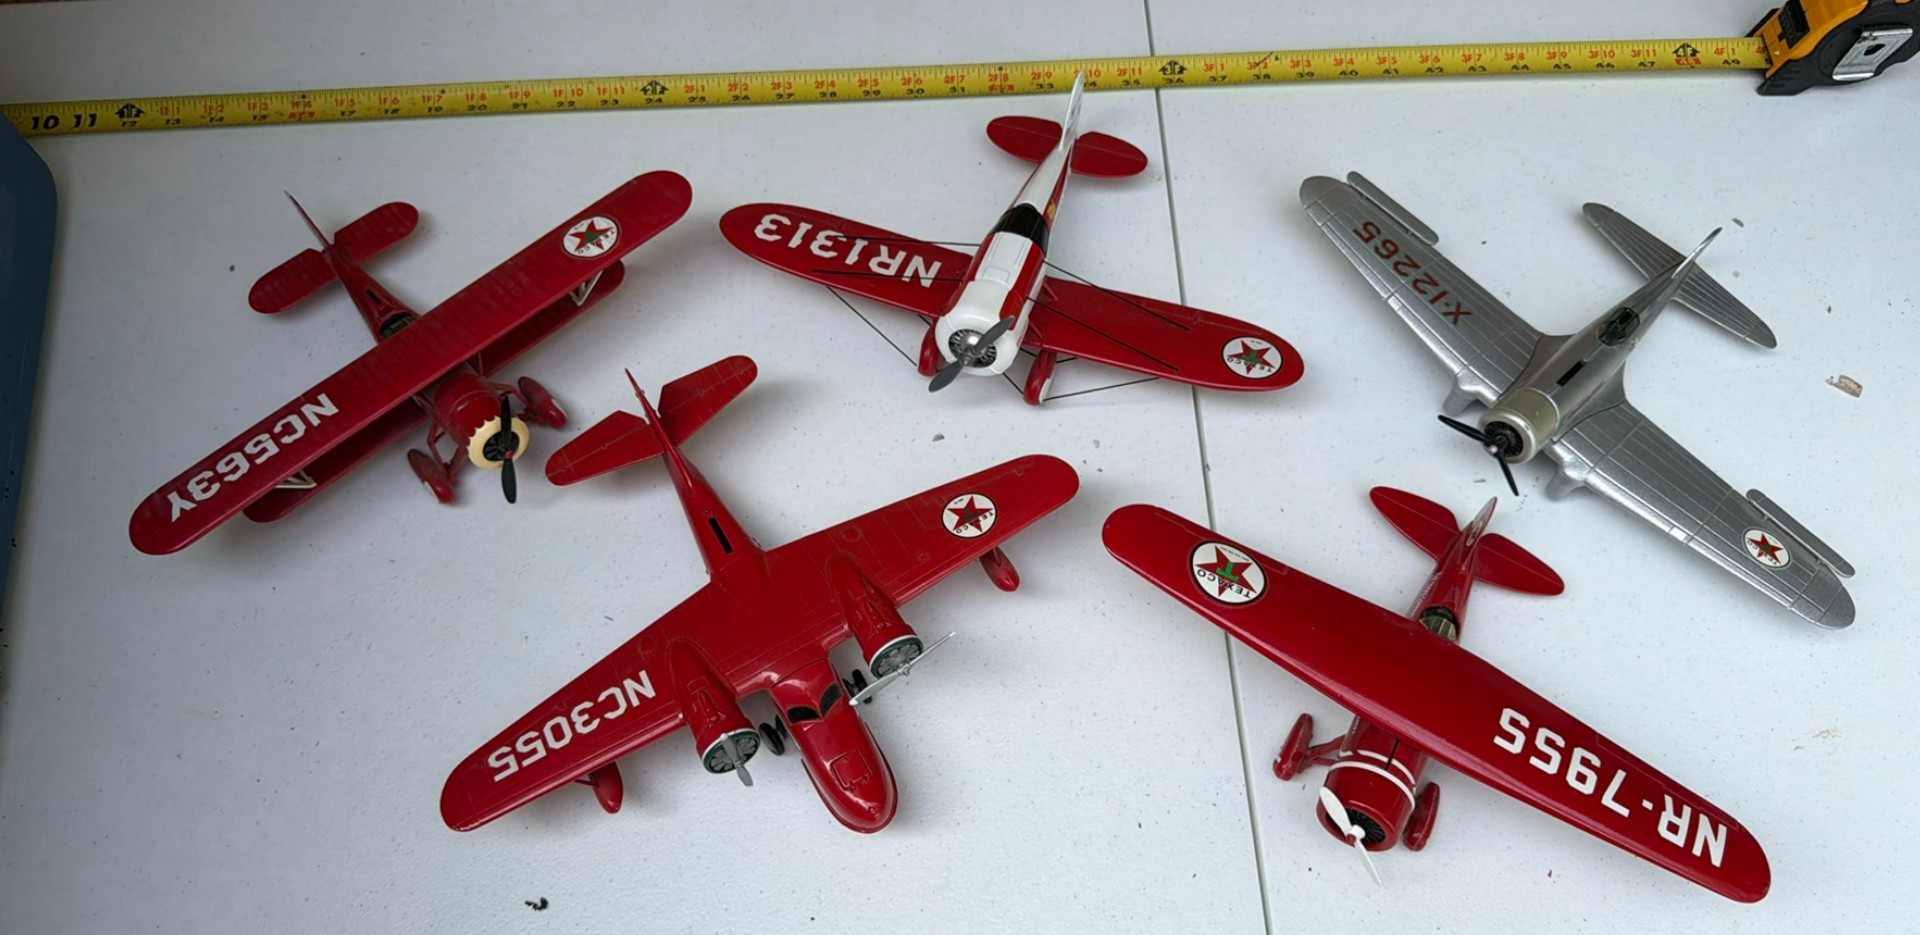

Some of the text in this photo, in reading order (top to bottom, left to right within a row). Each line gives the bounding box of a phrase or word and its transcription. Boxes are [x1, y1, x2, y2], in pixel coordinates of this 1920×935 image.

[1560, 50, 1567, 59] 9
[1602, 49, 1615, 58] 10
[1646, 48, 1655, 57] 11
[1731, 47, 1735, 55] 1
[1390, 56, 1397, 64] 5
[1432, 54, 1439, 63] 6
[1474, 53, 1481, 62] 7
[1517, 52, 1524, 60] 8
[1304, 59, 1311, 68] 3
[1346, 58, 1354, 66] 4
[1131, 67, 1142, 76] 11
[1220, 63, 1224, 71] 1
[959, 74, 966, 83] 7
[1002, 73, 1008, 81] 8
[1044, 71, 1052, 80] 9
[785, 81, 792, 89] 3
[828, 79, 835, 88] 4
[872, 77, 879, 86] 5
[914, 76, 922, 85] 6
[614, 87, 624, 95] 11
[700, 84, 704, 92] 1
[742, 82, 748, 91] 2
[480, 92, 486, 101] 8
[523, 90, 530, 99] 9
[571, 88, 582, 97] 10
[349, 98, 355, 107] 5
[392, 96, 400, 105] 6
[434, 94, 442, 103] 7
[31, 115, 59, 129] 10
[73, 113, 97, 128] 11
[577, 229, 615, 254] TEXACO
[753, 212, 943, 288] NR1313
[1227, 357, 1272, 373] TEXACO
[166, 392, 341, 523] NC563Y
[956, 512, 994, 534] TEXACO
[1216, 561, 1239, 582] T
[1197, 569, 1251, 599] TEXACO
[487, 668, 657, 784] NC3055
[1492, 705, 1730, 869] NR-7955
